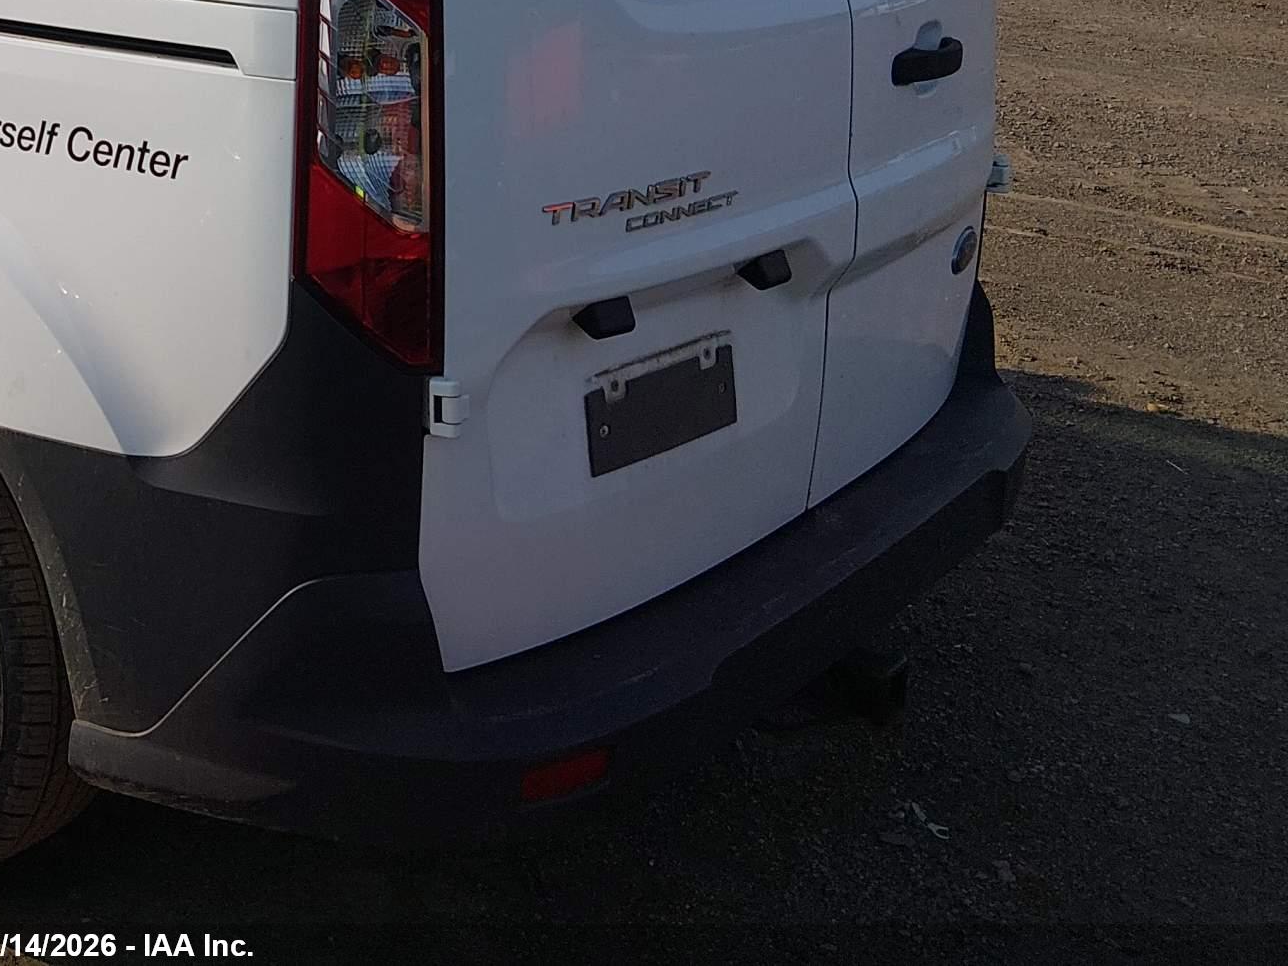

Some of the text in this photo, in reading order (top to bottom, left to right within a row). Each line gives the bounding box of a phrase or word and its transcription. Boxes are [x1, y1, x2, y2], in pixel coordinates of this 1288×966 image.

[67, 126, 189, 180] Center
[542, 170, 712, 226] TRANSIT
[625, 190, 739, 233] CONNECT
